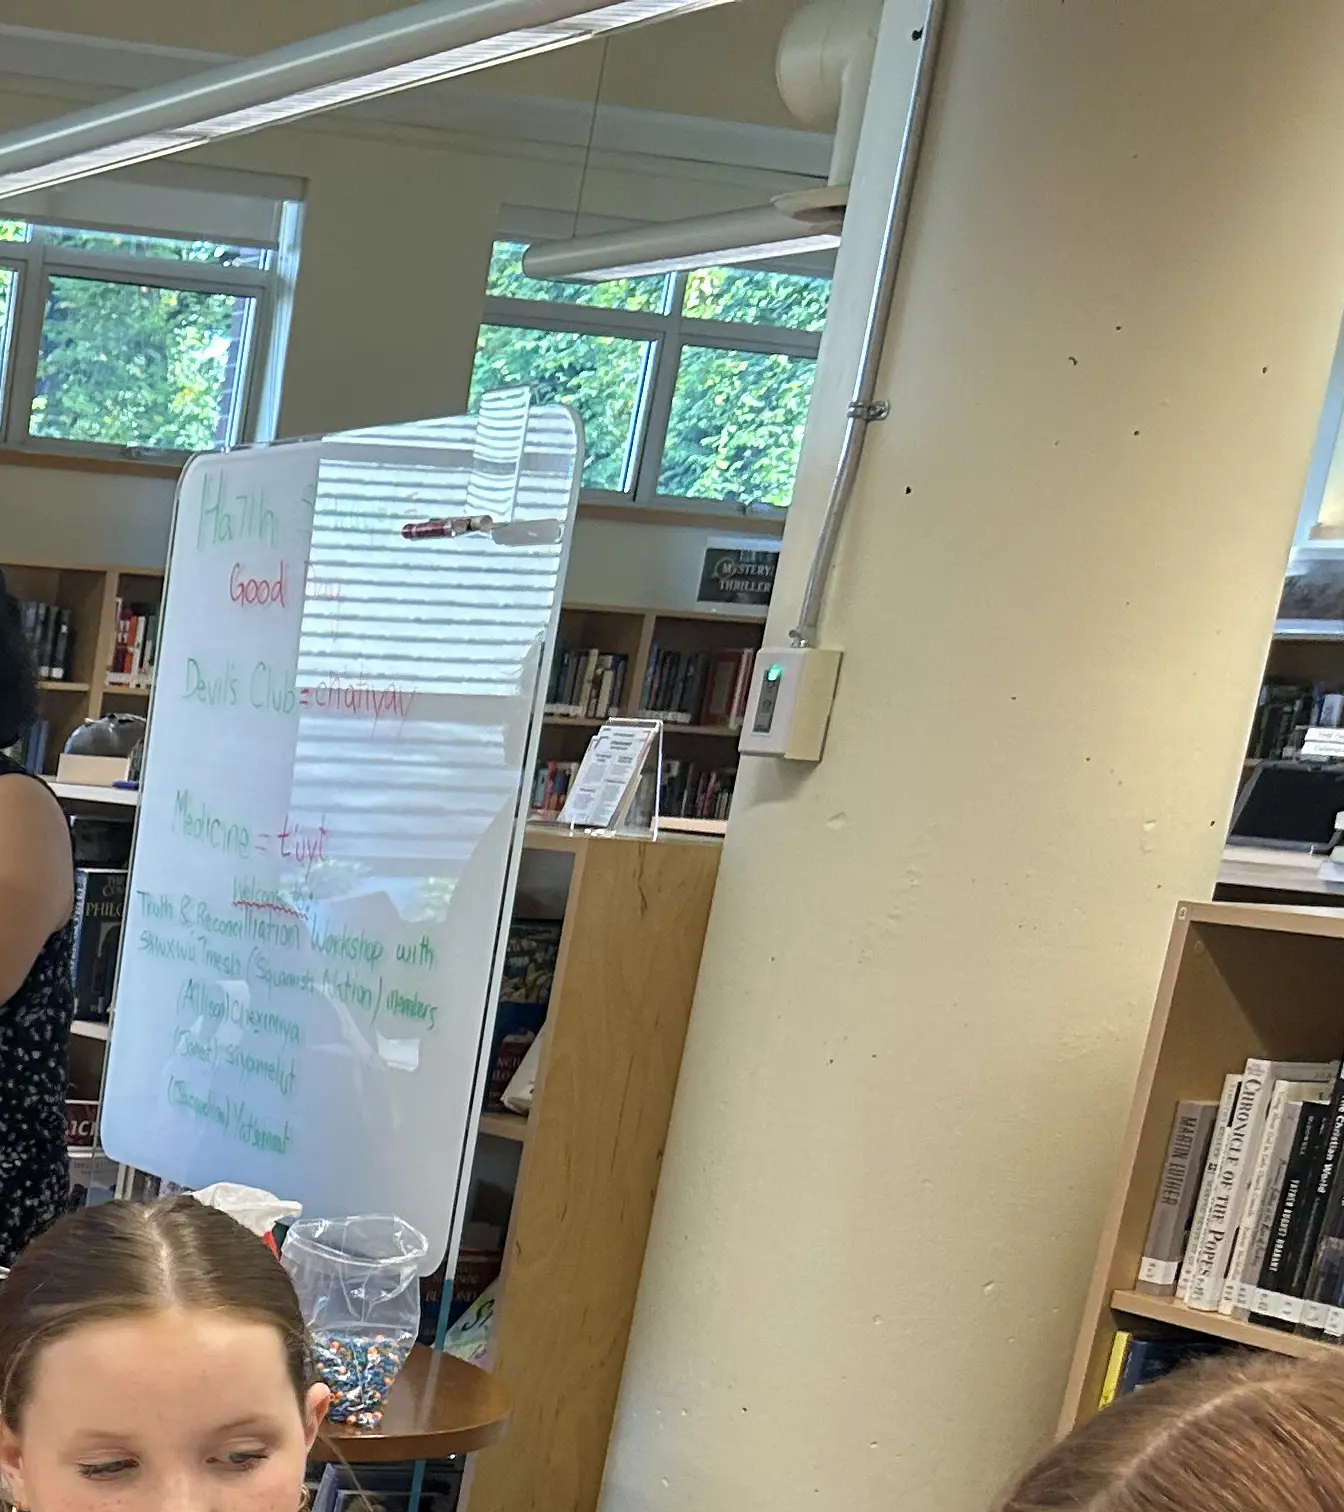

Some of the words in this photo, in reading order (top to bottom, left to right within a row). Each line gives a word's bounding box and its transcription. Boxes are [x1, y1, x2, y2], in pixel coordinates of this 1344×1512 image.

[230, 560, 285, 609] Good
[250, 661, 296, 714] Club
[172, 789, 250, 859] Medicine
[137, 890, 173, 920] Truth
[311, 915, 384, 965] Workshop
[395, 934, 435, 973] with
[1172, 1115, 1198, 1160] MARTIN
[1229, 1078, 1262, 1168] CHRONICLE
[1328, 1113, 1344, 1162] Christian
[1162, 1162, 1186, 1206] LUTHER
[1220, 1171, 1235, 1188] OF
[1317, 1161, 1334, 1194] World
[1212, 1194, 1230, 1221] THE
[1200, 1228, 1225, 1277] POPES
